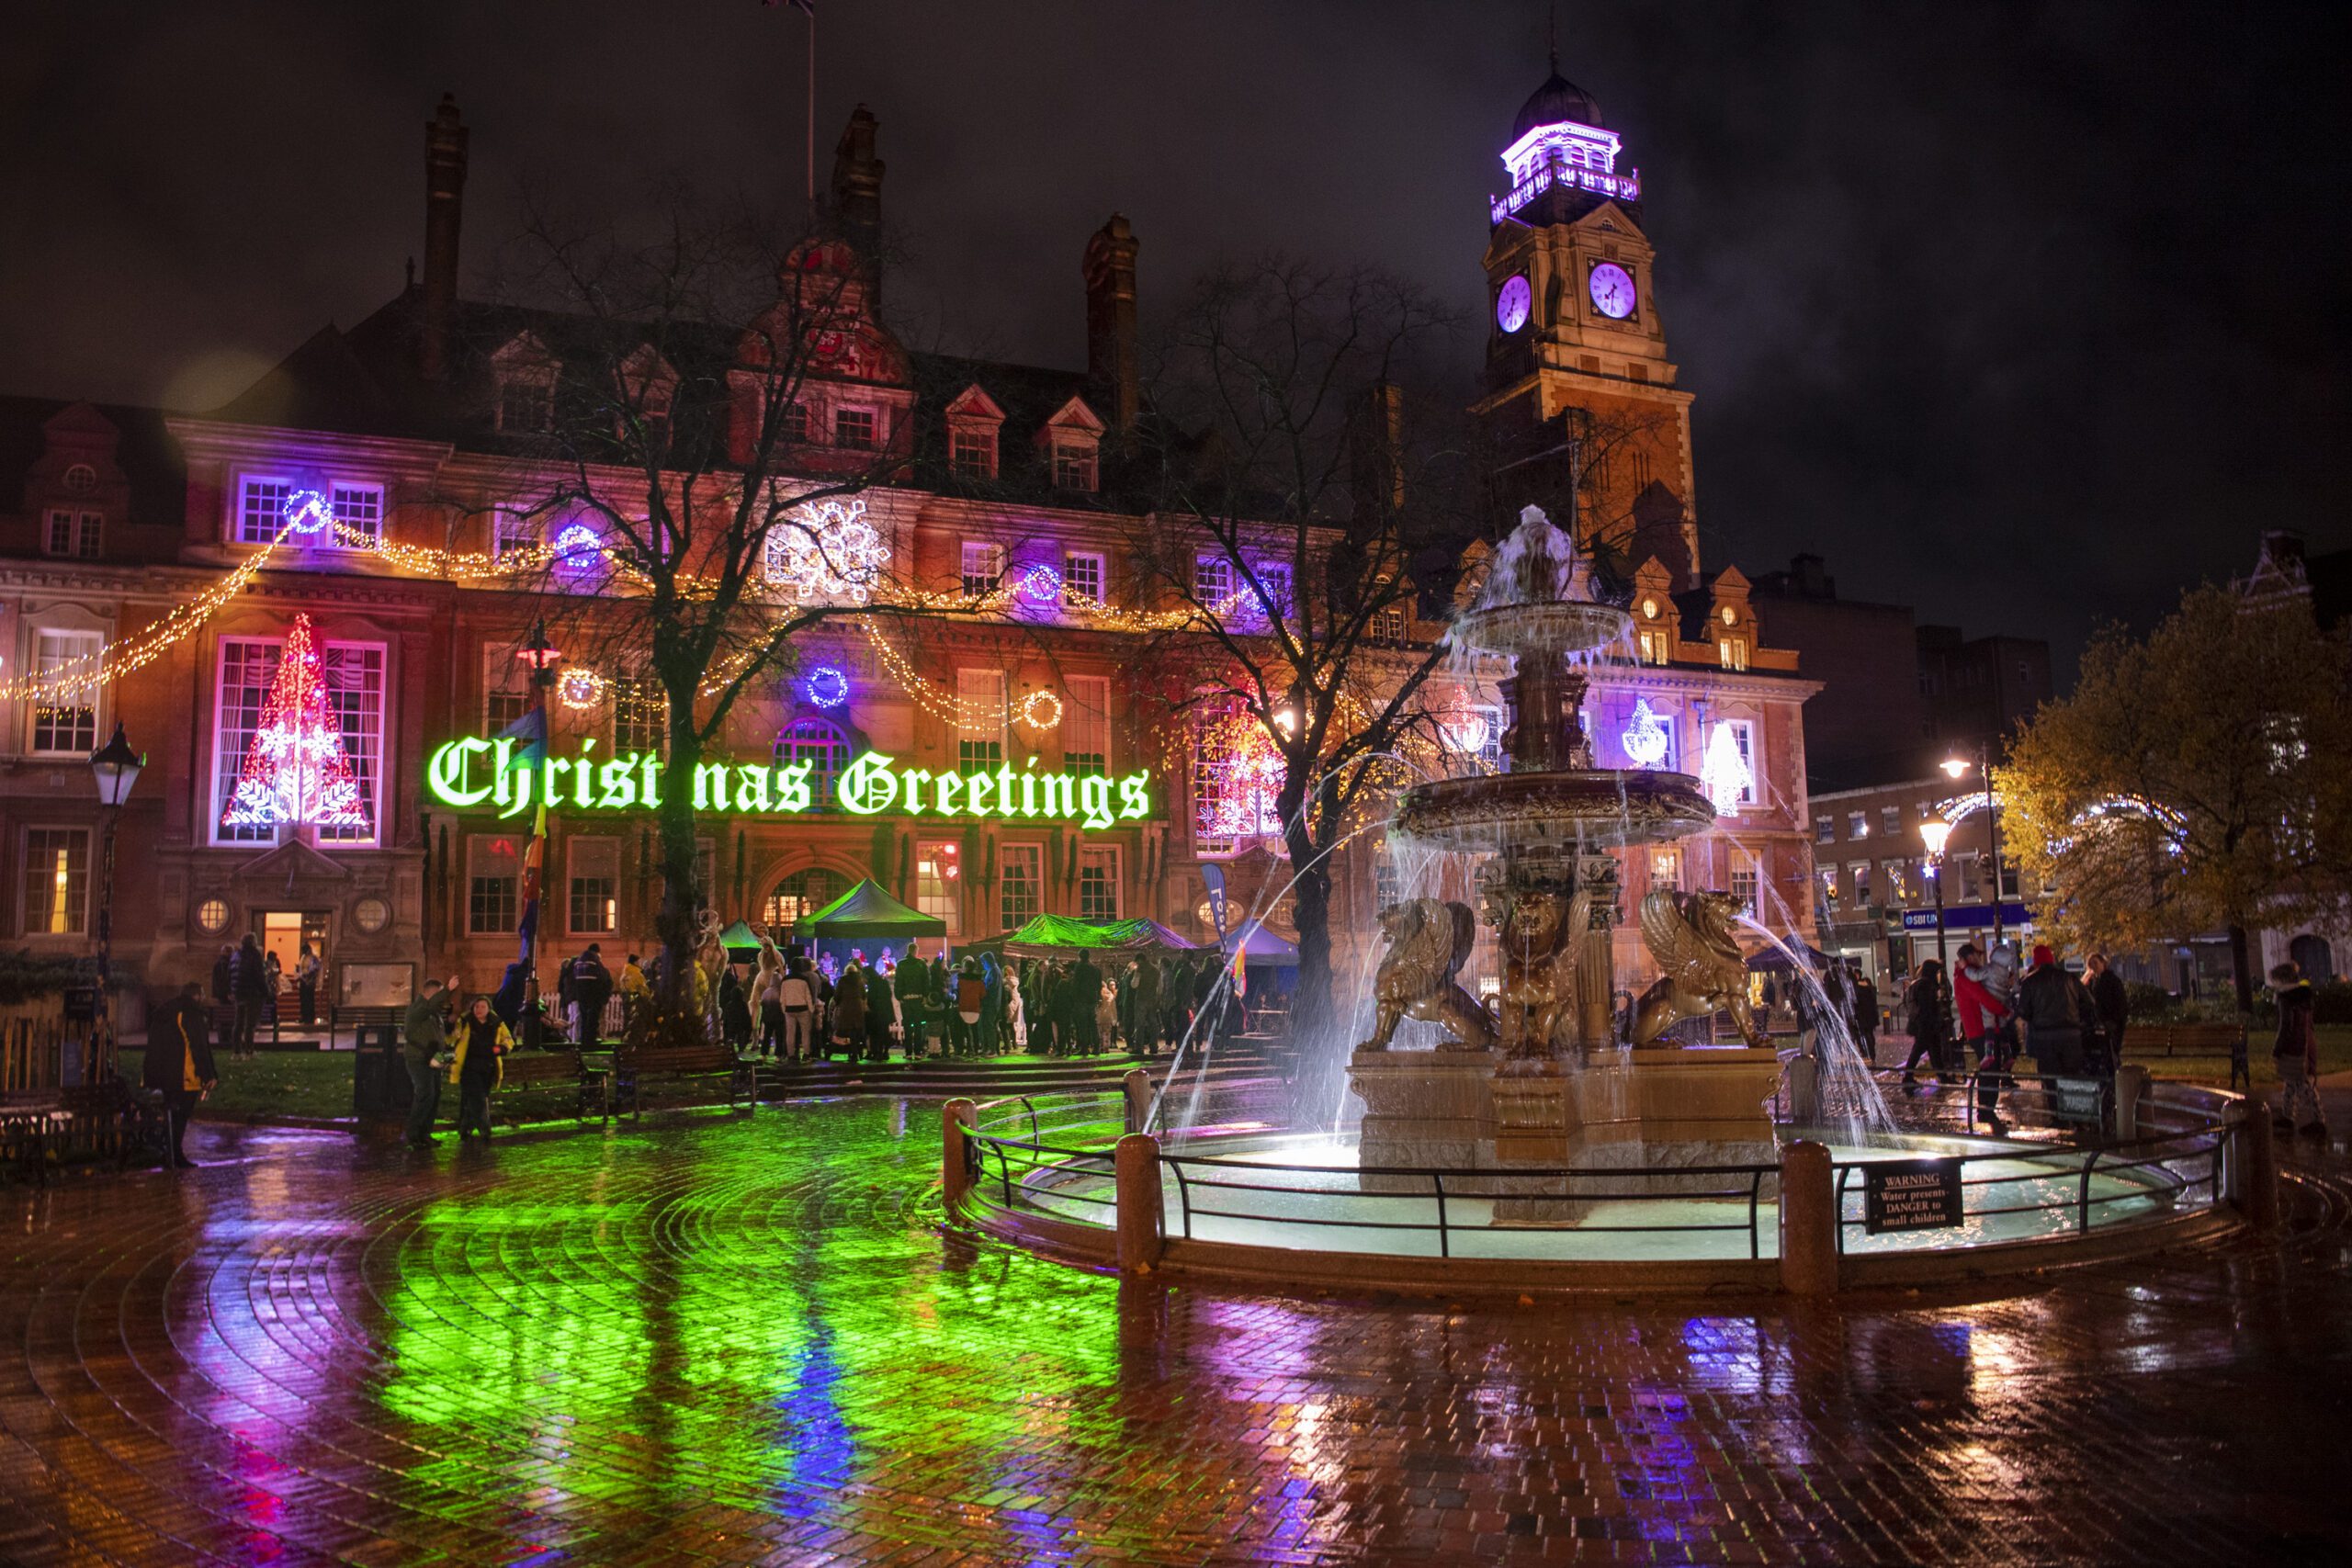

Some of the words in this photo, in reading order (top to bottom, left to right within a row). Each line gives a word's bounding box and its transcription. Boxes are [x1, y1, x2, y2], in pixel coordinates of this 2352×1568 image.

[838, 750, 1149, 829] Greetings
[1914, 915, 1926, 925] SBI
[1884, 1173, 1939, 1187] WARNING
[1881, 1192, 1906, 1201] Water
[1911, 1190, 1945, 1201] presents
[1886, 1201, 1928, 1213] DANGER
[1883, 1215, 1906, 1225] small
[1910, 1213, 1946, 1224] children
